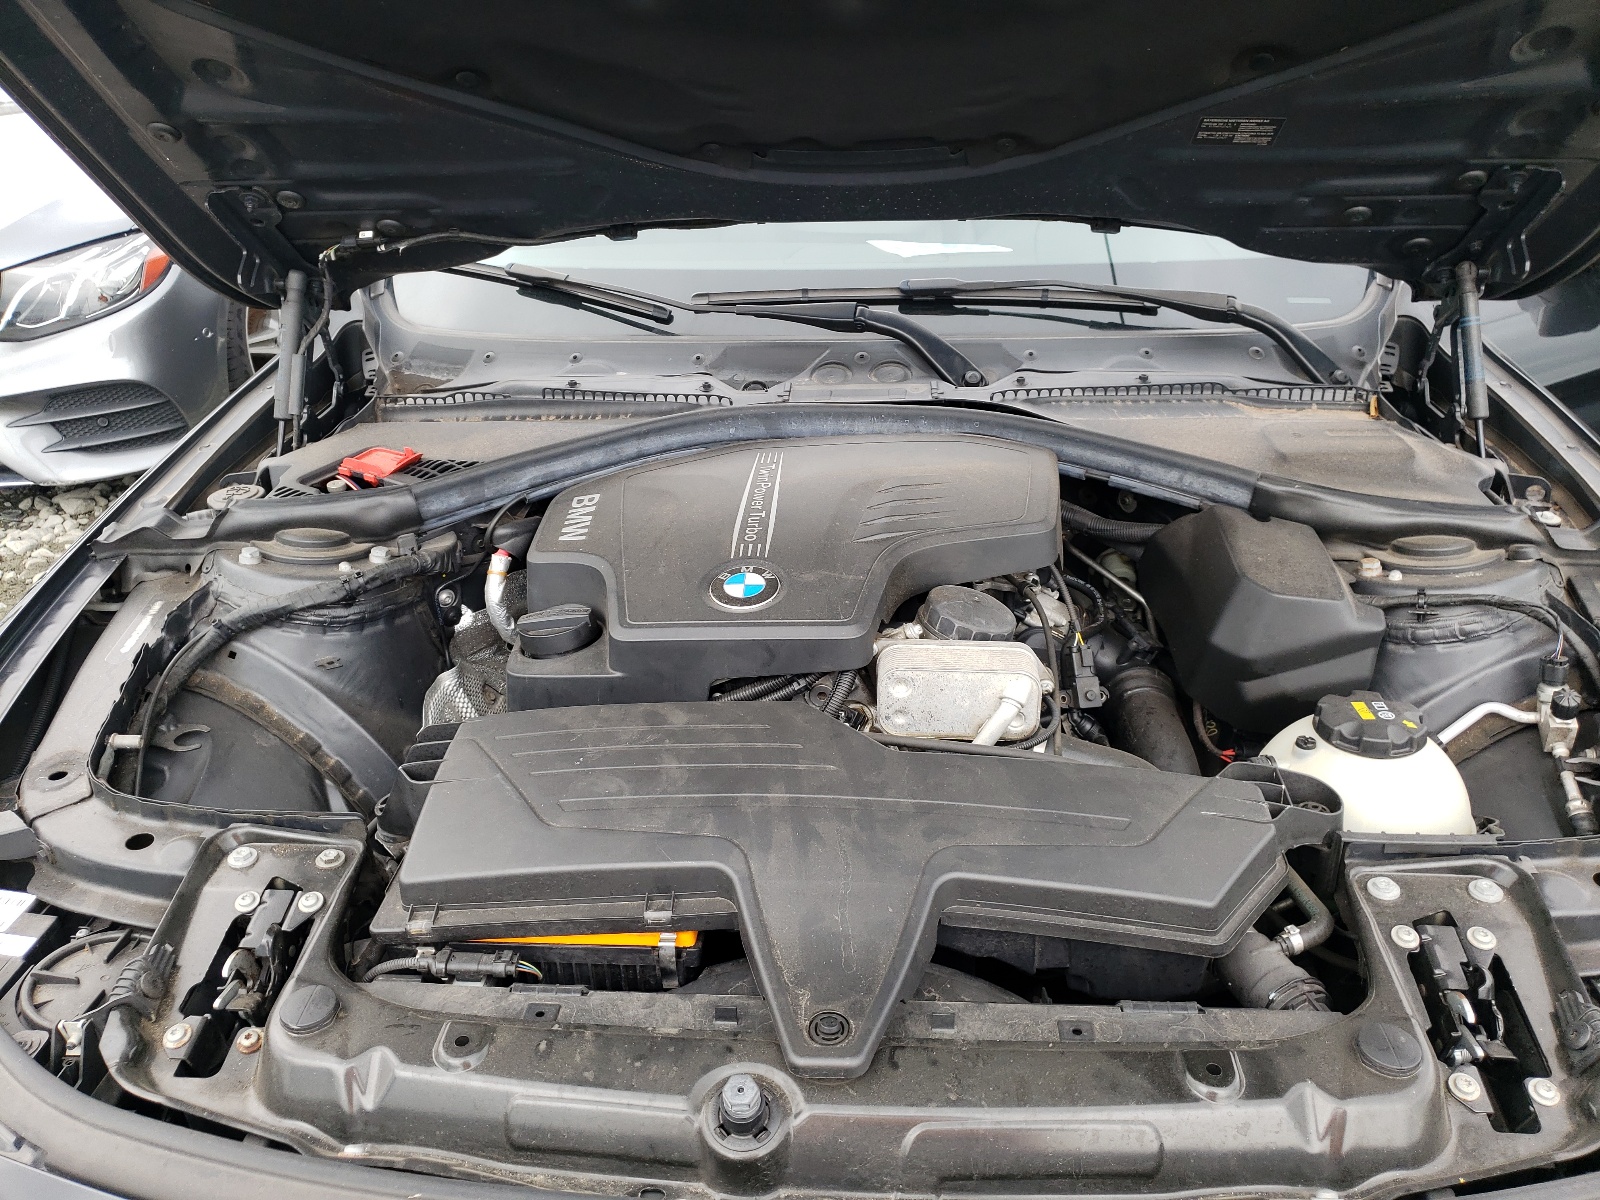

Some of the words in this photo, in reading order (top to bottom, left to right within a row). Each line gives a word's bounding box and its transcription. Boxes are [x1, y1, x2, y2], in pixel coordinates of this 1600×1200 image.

[750, 463, 776, 510] TwinPower
[558, 493, 601, 541] BMW
[744, 510, 766, 542] Turbo
